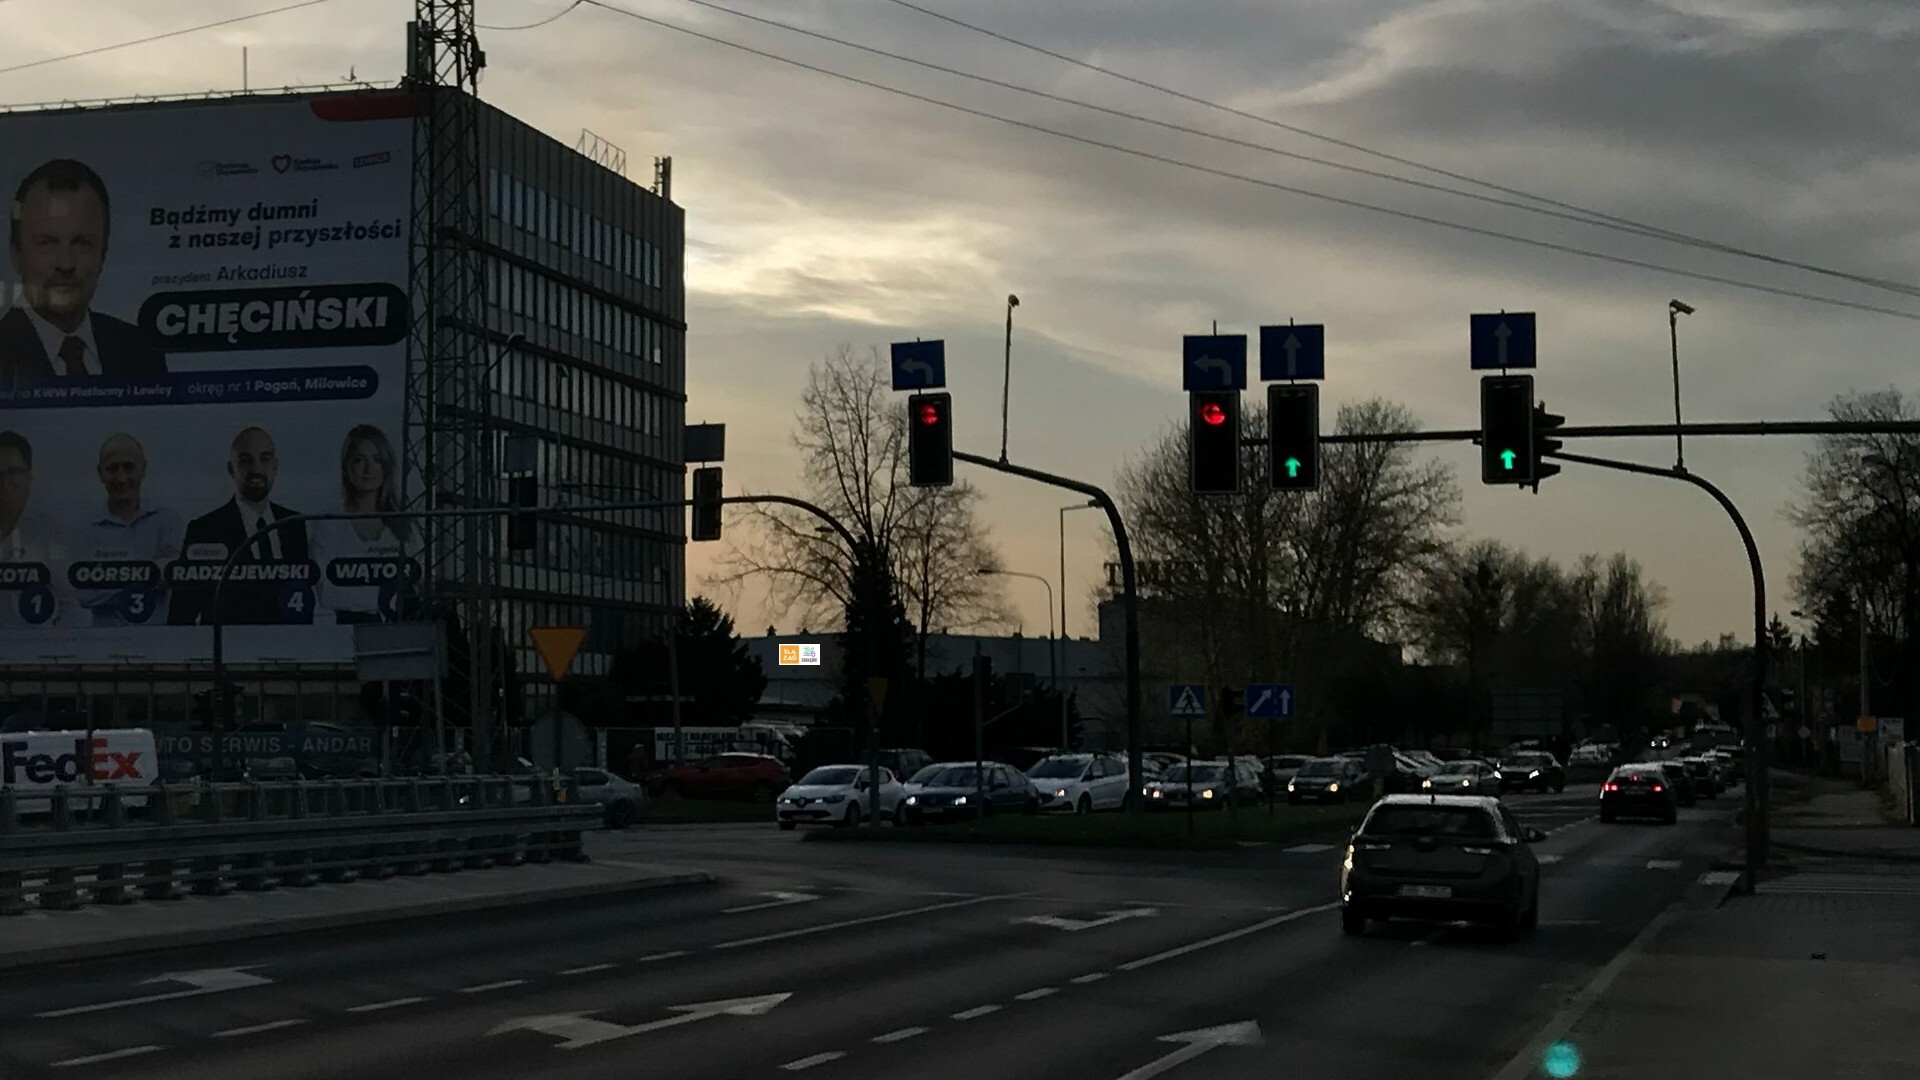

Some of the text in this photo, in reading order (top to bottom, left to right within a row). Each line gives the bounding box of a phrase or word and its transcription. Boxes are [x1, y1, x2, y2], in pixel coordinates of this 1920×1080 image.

[149, 199, 318, 230] Bądźmy dumni
[168, 218, 402, 250] z naszej przyszłości
[151, 263, 308, 287] prezydent Arkadiusz
[155, 290, 389, 344] CHĘCIŃSKI
[33, 387, 68, 398] KWW
[70, 385, 124, 399] Platformy
[134, 383, 173, 398] Lewicy
[187, 381, 224, 397] okręg
[227, 382, 240, 392] nr
[244, 380, 251, 391] 1
[254, 377, 301, 395] Pogoń,
[304, 375, 369, 390] Milowice
[0, 566, 40, 583] OTA
[75, 563, 151, 582] GÓRSKI
[31, 593, 42, 615] 1
[129, 593, 145, 615] 3
[287, 591, 304, 612] 4
[302, 736, 372, 752] ANDAR
[2, 738, 143, 784] FedEx
